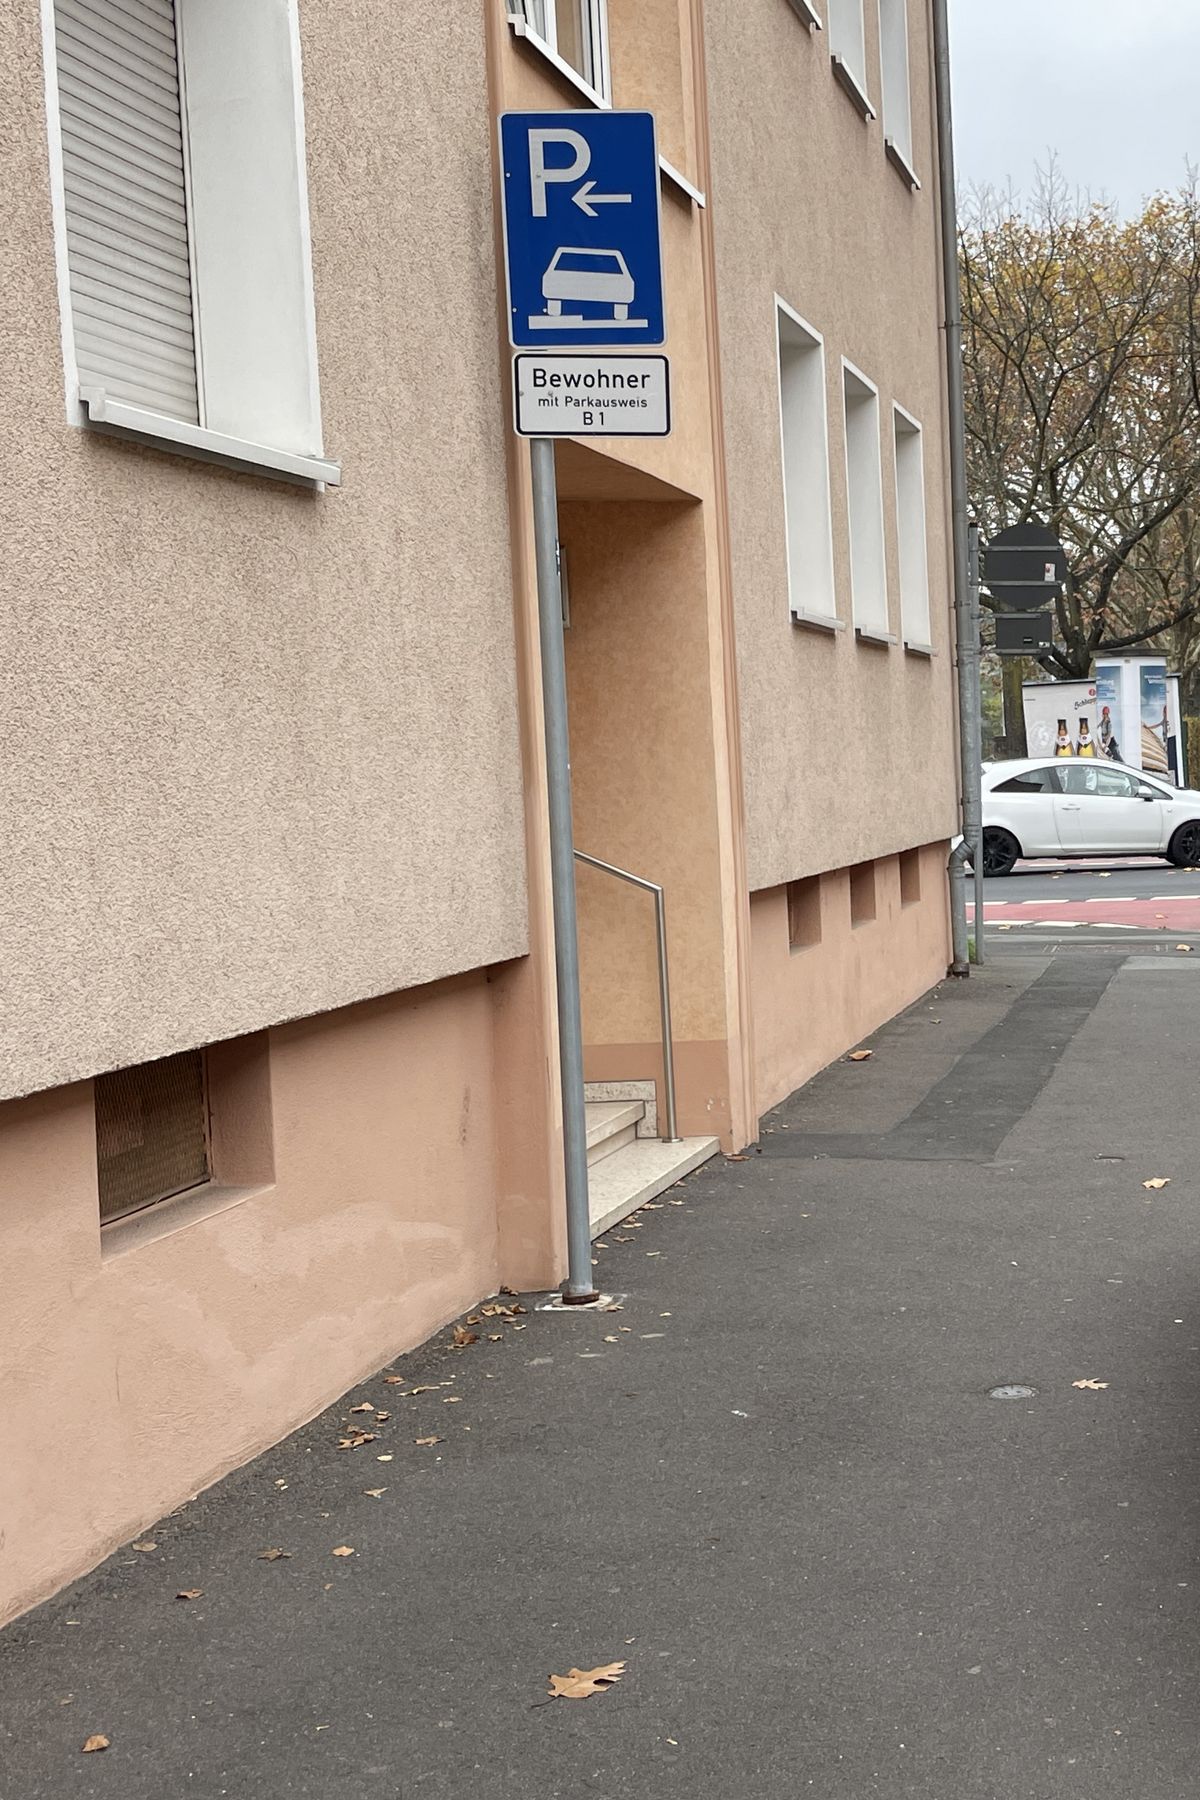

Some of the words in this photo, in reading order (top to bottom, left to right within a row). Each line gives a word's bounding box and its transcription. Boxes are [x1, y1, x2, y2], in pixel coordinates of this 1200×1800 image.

[528, 128, 591, 217] P
[533, 368, 651, 389] Bewohner
[538, 396, 559, 407] mit
[565, 395, 648, 408] Parkausweis
